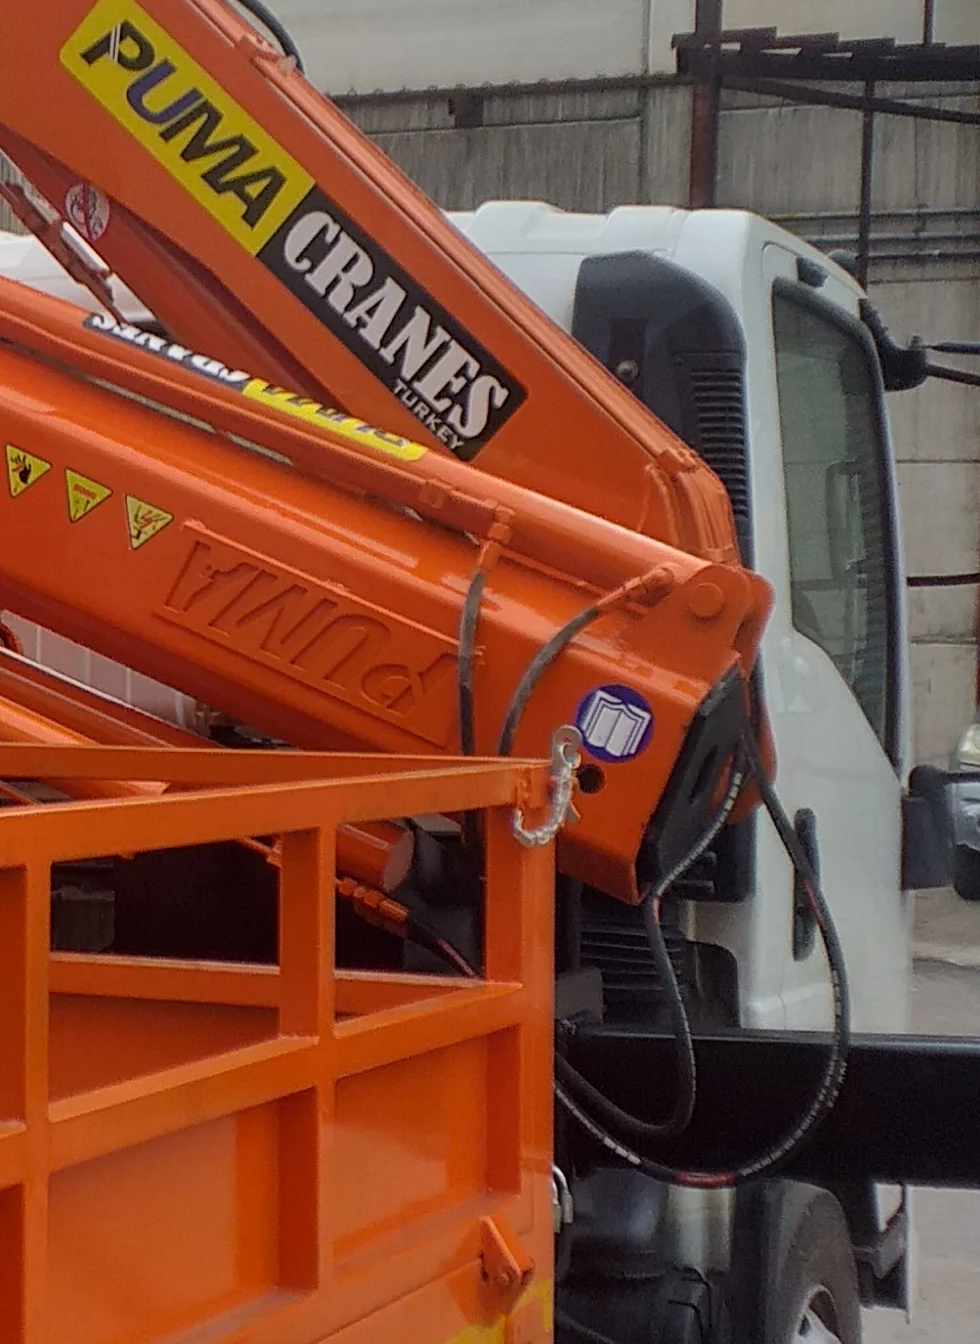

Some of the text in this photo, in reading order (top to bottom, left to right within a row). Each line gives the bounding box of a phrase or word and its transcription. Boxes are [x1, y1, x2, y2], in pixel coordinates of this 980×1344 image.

[79, 19, 509, 439] PUMA CRANES
[393, 378, 465, 450] TURKEY
[162, 540, 460, 718] PUMA
